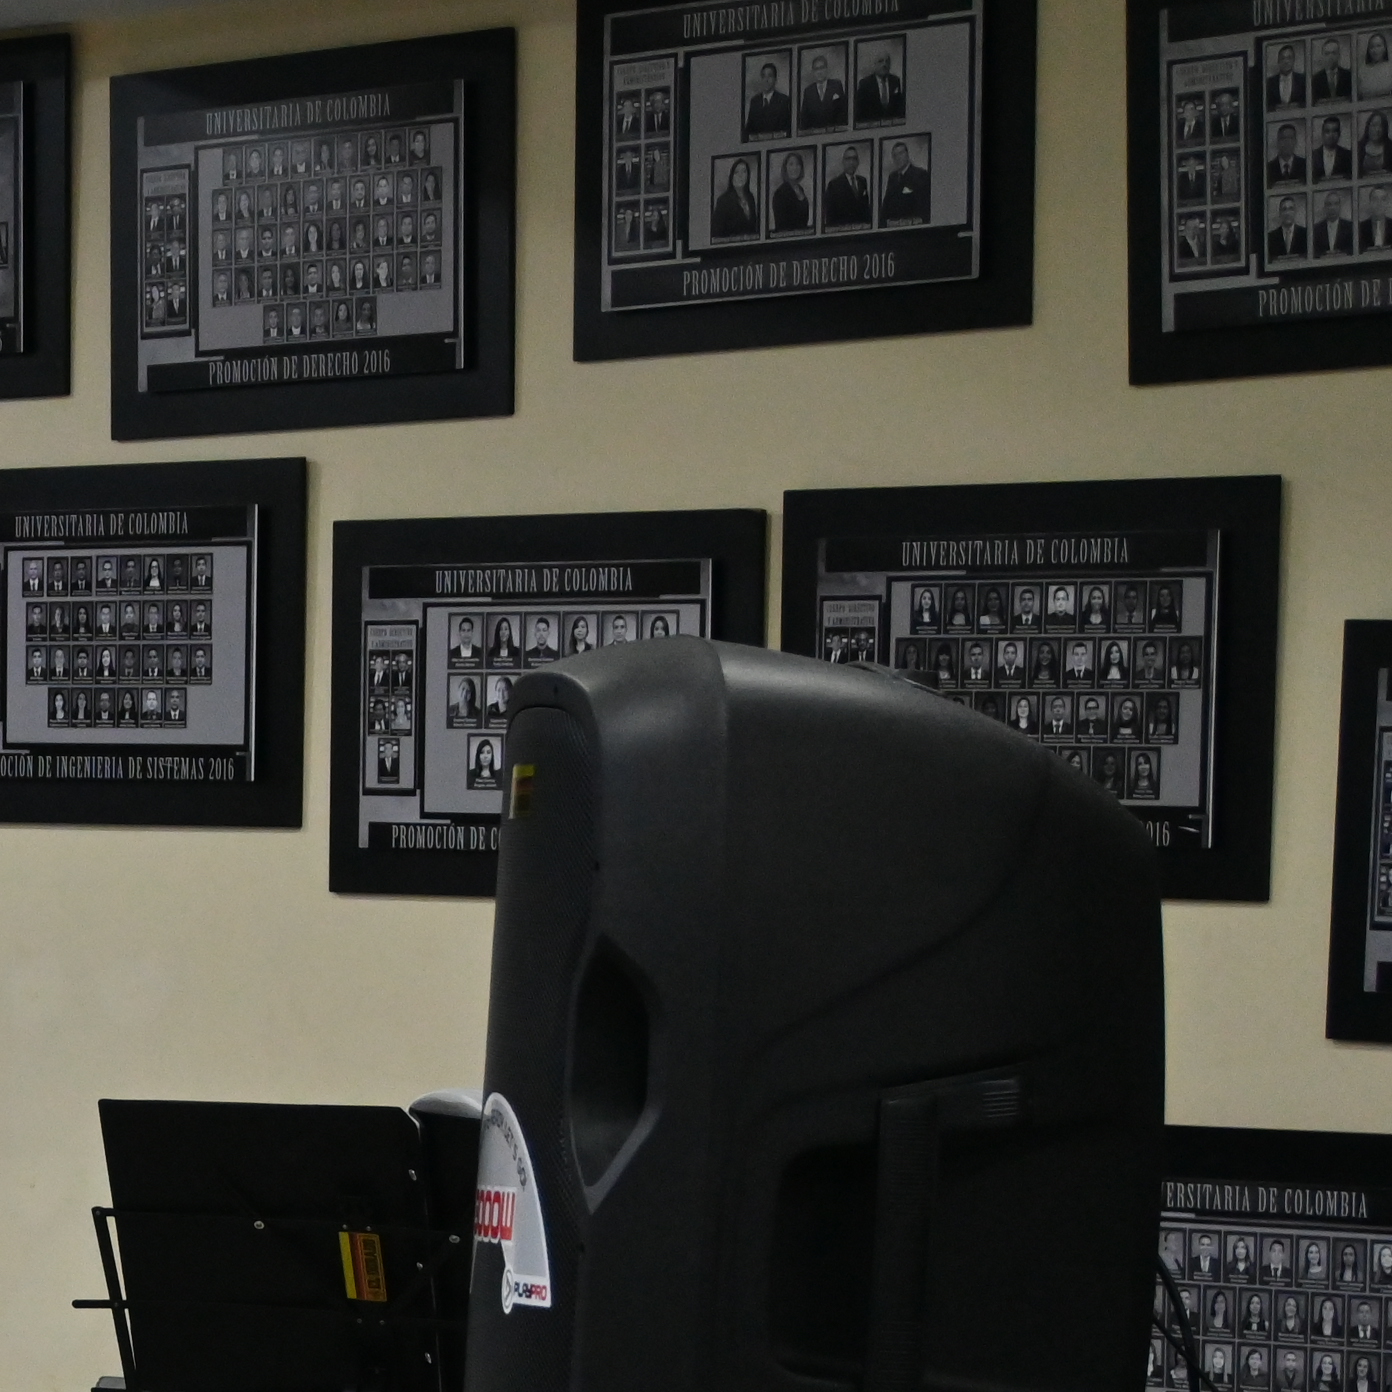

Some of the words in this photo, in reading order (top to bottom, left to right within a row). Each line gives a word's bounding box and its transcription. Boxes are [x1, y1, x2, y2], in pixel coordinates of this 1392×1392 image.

[683, 2, 794, 39] UNIVERSITARIA
[801, 0, 818, 23] DE
[206, 103, 301, 135] UNIVERSITARIA
[307, 101, 322, 123] DE
[326, 93, 391, 121] COLOMBIA
[683, 261, 764, 296] PROMOCIÓN
[769, 262, 786, 287] DE
[792, 256, 857, 285] DERECHO
[863, 252, 896, 280] 2016
[1258, 278, 1353, 317] PROMOCIÓN
[1361, 278, 1381, 307] DE
[208, 355, 277, 385] PROMOCIÓN
[283, 356, 299, 379] DE
[303, 352, 358, 377] DERECHO
[363, 349, 391, 374] 2016
[14, 514, 105, 538] UNIVERSITARIA
[109, 513, 125, 536] DE
[128, 511, 189, 535] COLOMBIA
[902, 541, 1018, 566] UNIVERSITARIA
[1026, 539, 1045, 565] DE
[1050, 537, 1130, 564] COLOMBIA
[435, 569, 538, 594] UNIVERSITARIA
[543, 569, 560, 592] DE
[564, 567, 633, 592] COLOMBIA
[37, 755, 52, 778] DE
[56, 755, 124, 779] INGENIERIA
[128, 756, 143, 780] DE
[146, 756, 205, 781] SISTEMAS
[208, 757, 235, 781] 2016
[391, 822, 465, 850] PROMOCIÓN
[470, 826, 486, 850] DE
[1145, 820, 1170, 847] 016
[1160, 1181, 1251, 1212] ERSITARIA
[1258, 1187, 1278, 1214] DE
[1284, 1188, 1367, 1219] COLOMBIA
